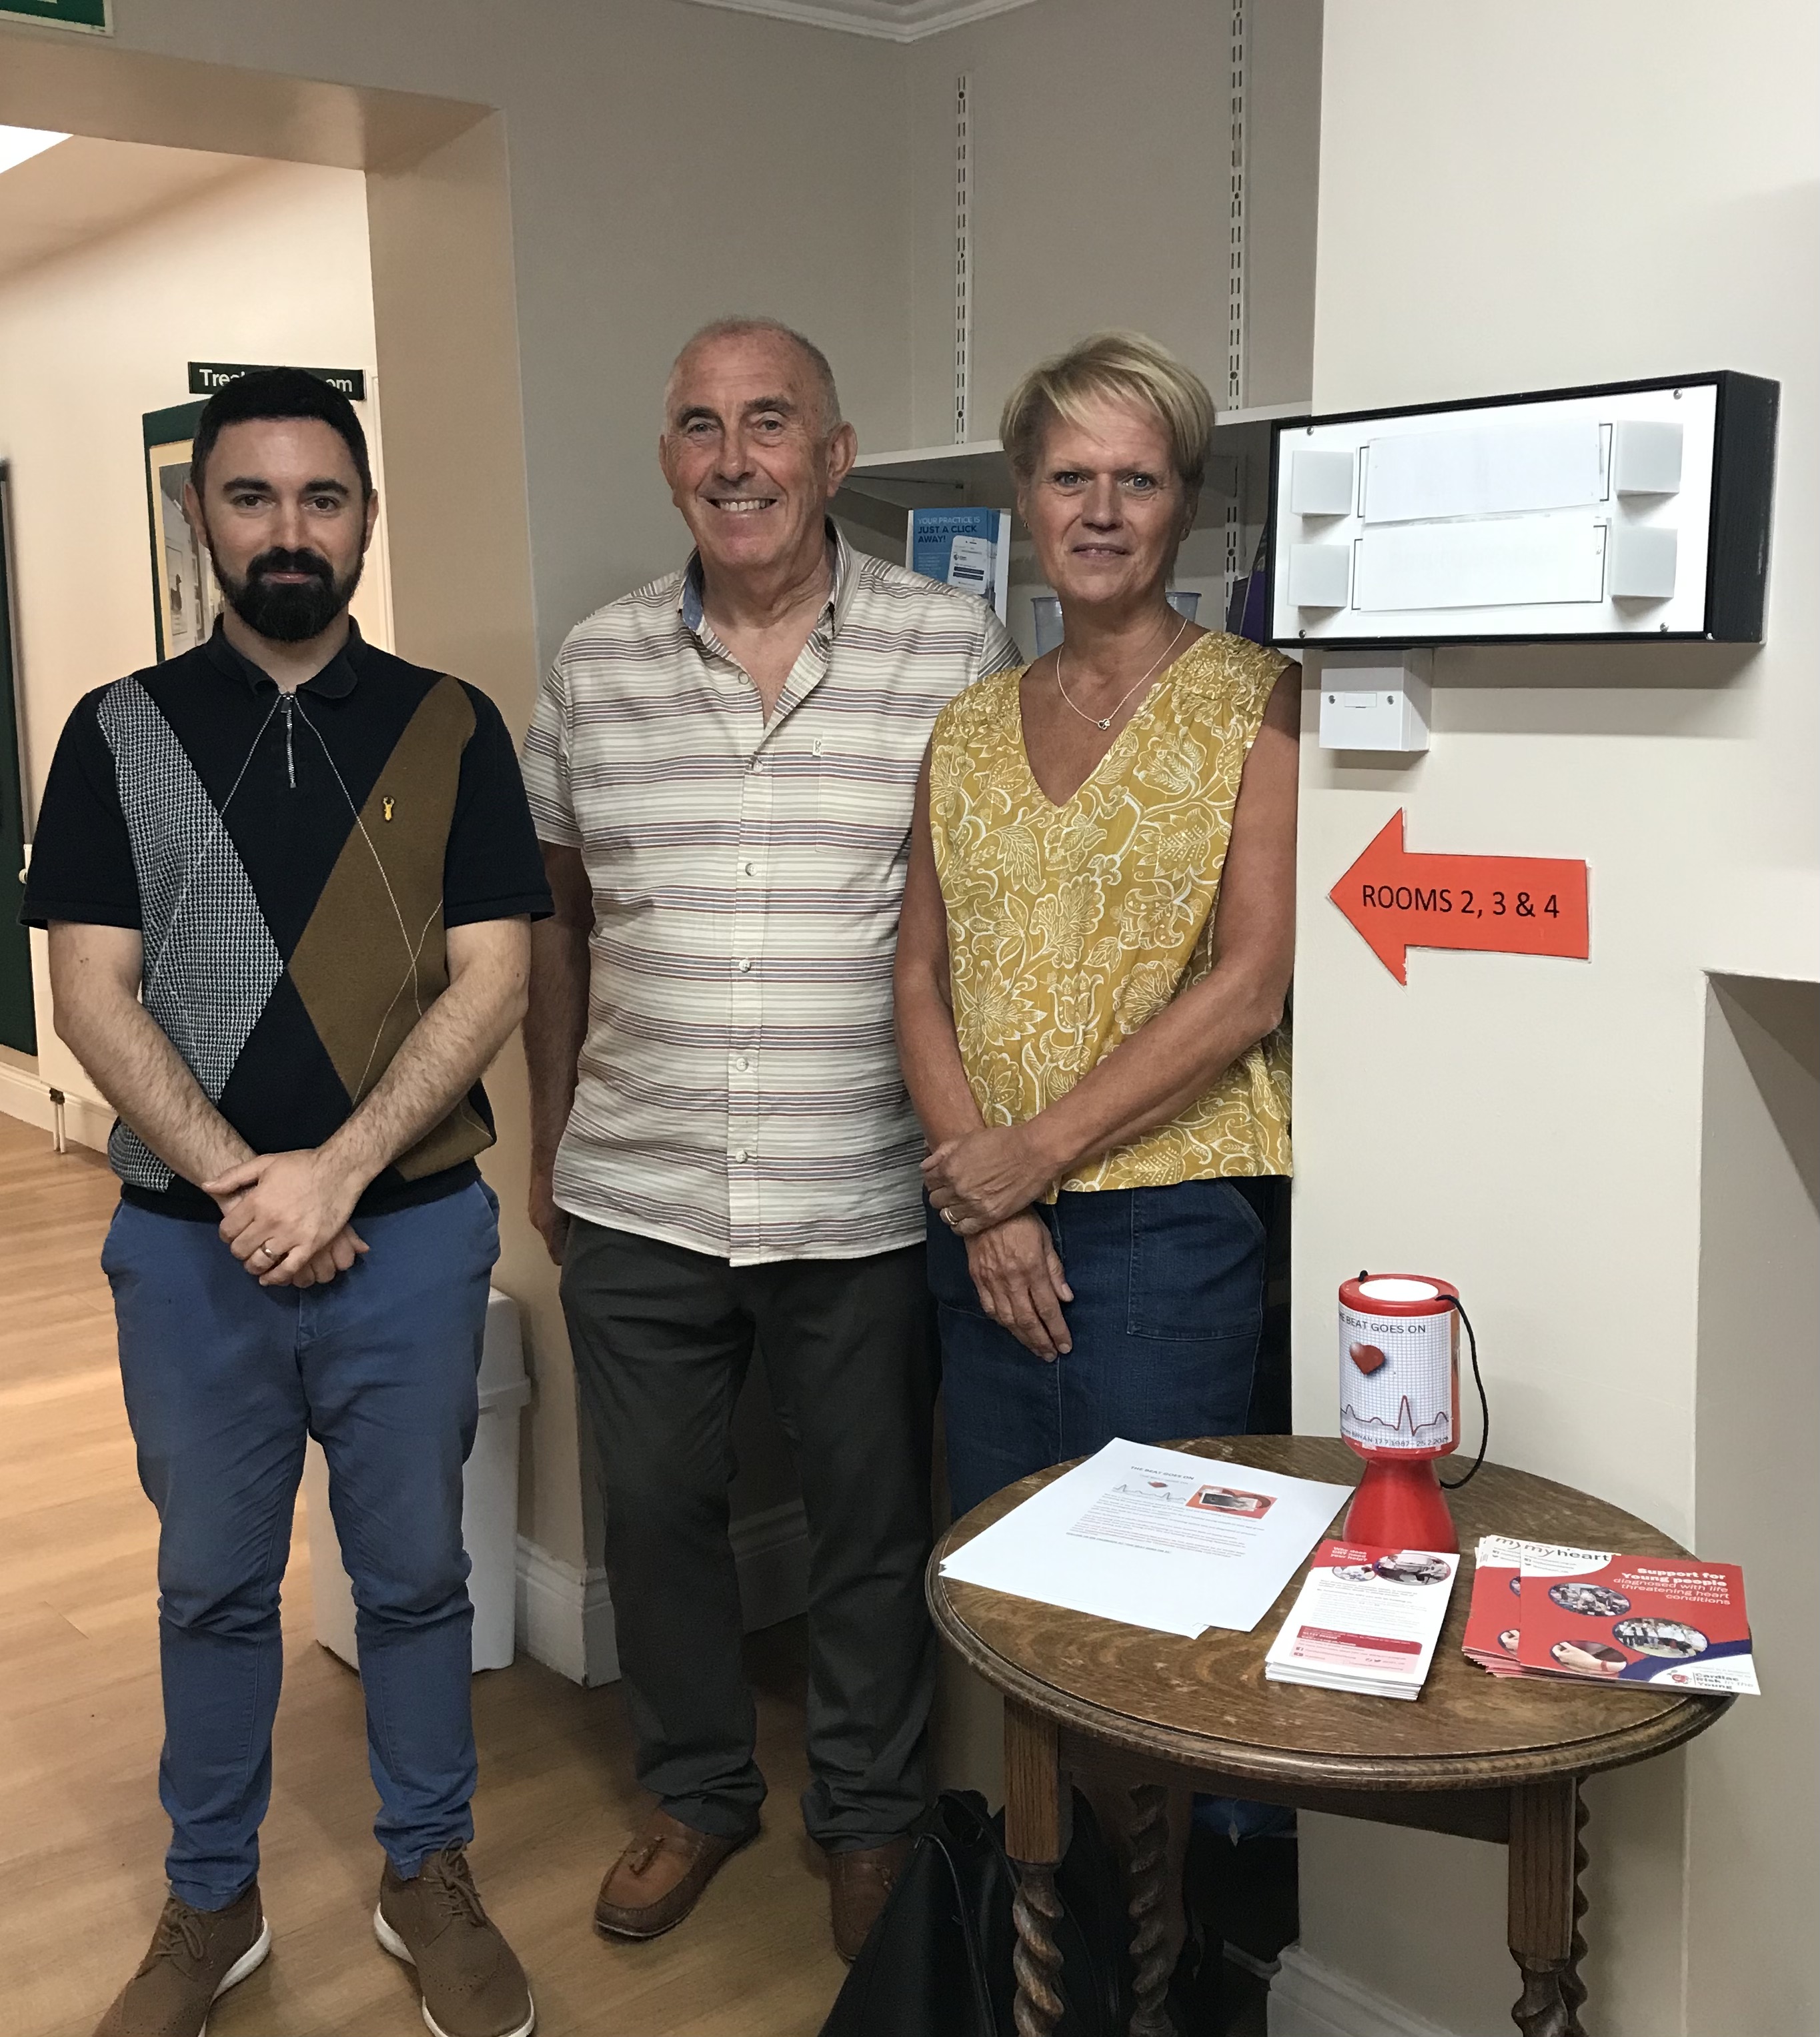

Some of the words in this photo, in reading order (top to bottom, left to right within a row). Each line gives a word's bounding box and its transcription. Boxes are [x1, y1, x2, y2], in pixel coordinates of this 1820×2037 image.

[918, 526, 940, 534] JUST
[951, 525, 977, 533] CLICK
[1362, 884, 1453, 913] ROOMS
[1461, 890, 1483, 918] 2,
[1493, 891, 1506, 915] 3
[1515, 892, 1535, 917] &
[1543, 894, 1560, 918] 4
[1346, 1315, 1368, 1329] BEAT
[1371, 1323, 1405, 1333] GOES
[1408, 1325, 1426, 1333] ON
[1637, 1567, 1699, 1578] Support
[1613, 1578, 1676, 1588] diagnosed
[1621, 1572, 1670, 1583] Young
[1673, 1577, 1727, 1587] people
[1621, 1584, 1693, 1596] threatening
[1696, 1590, 1729, 1599] heart
[1665, 1594, 1731, 1605] conditions
[1695, 1673, 1739, 1681] Cardiac
